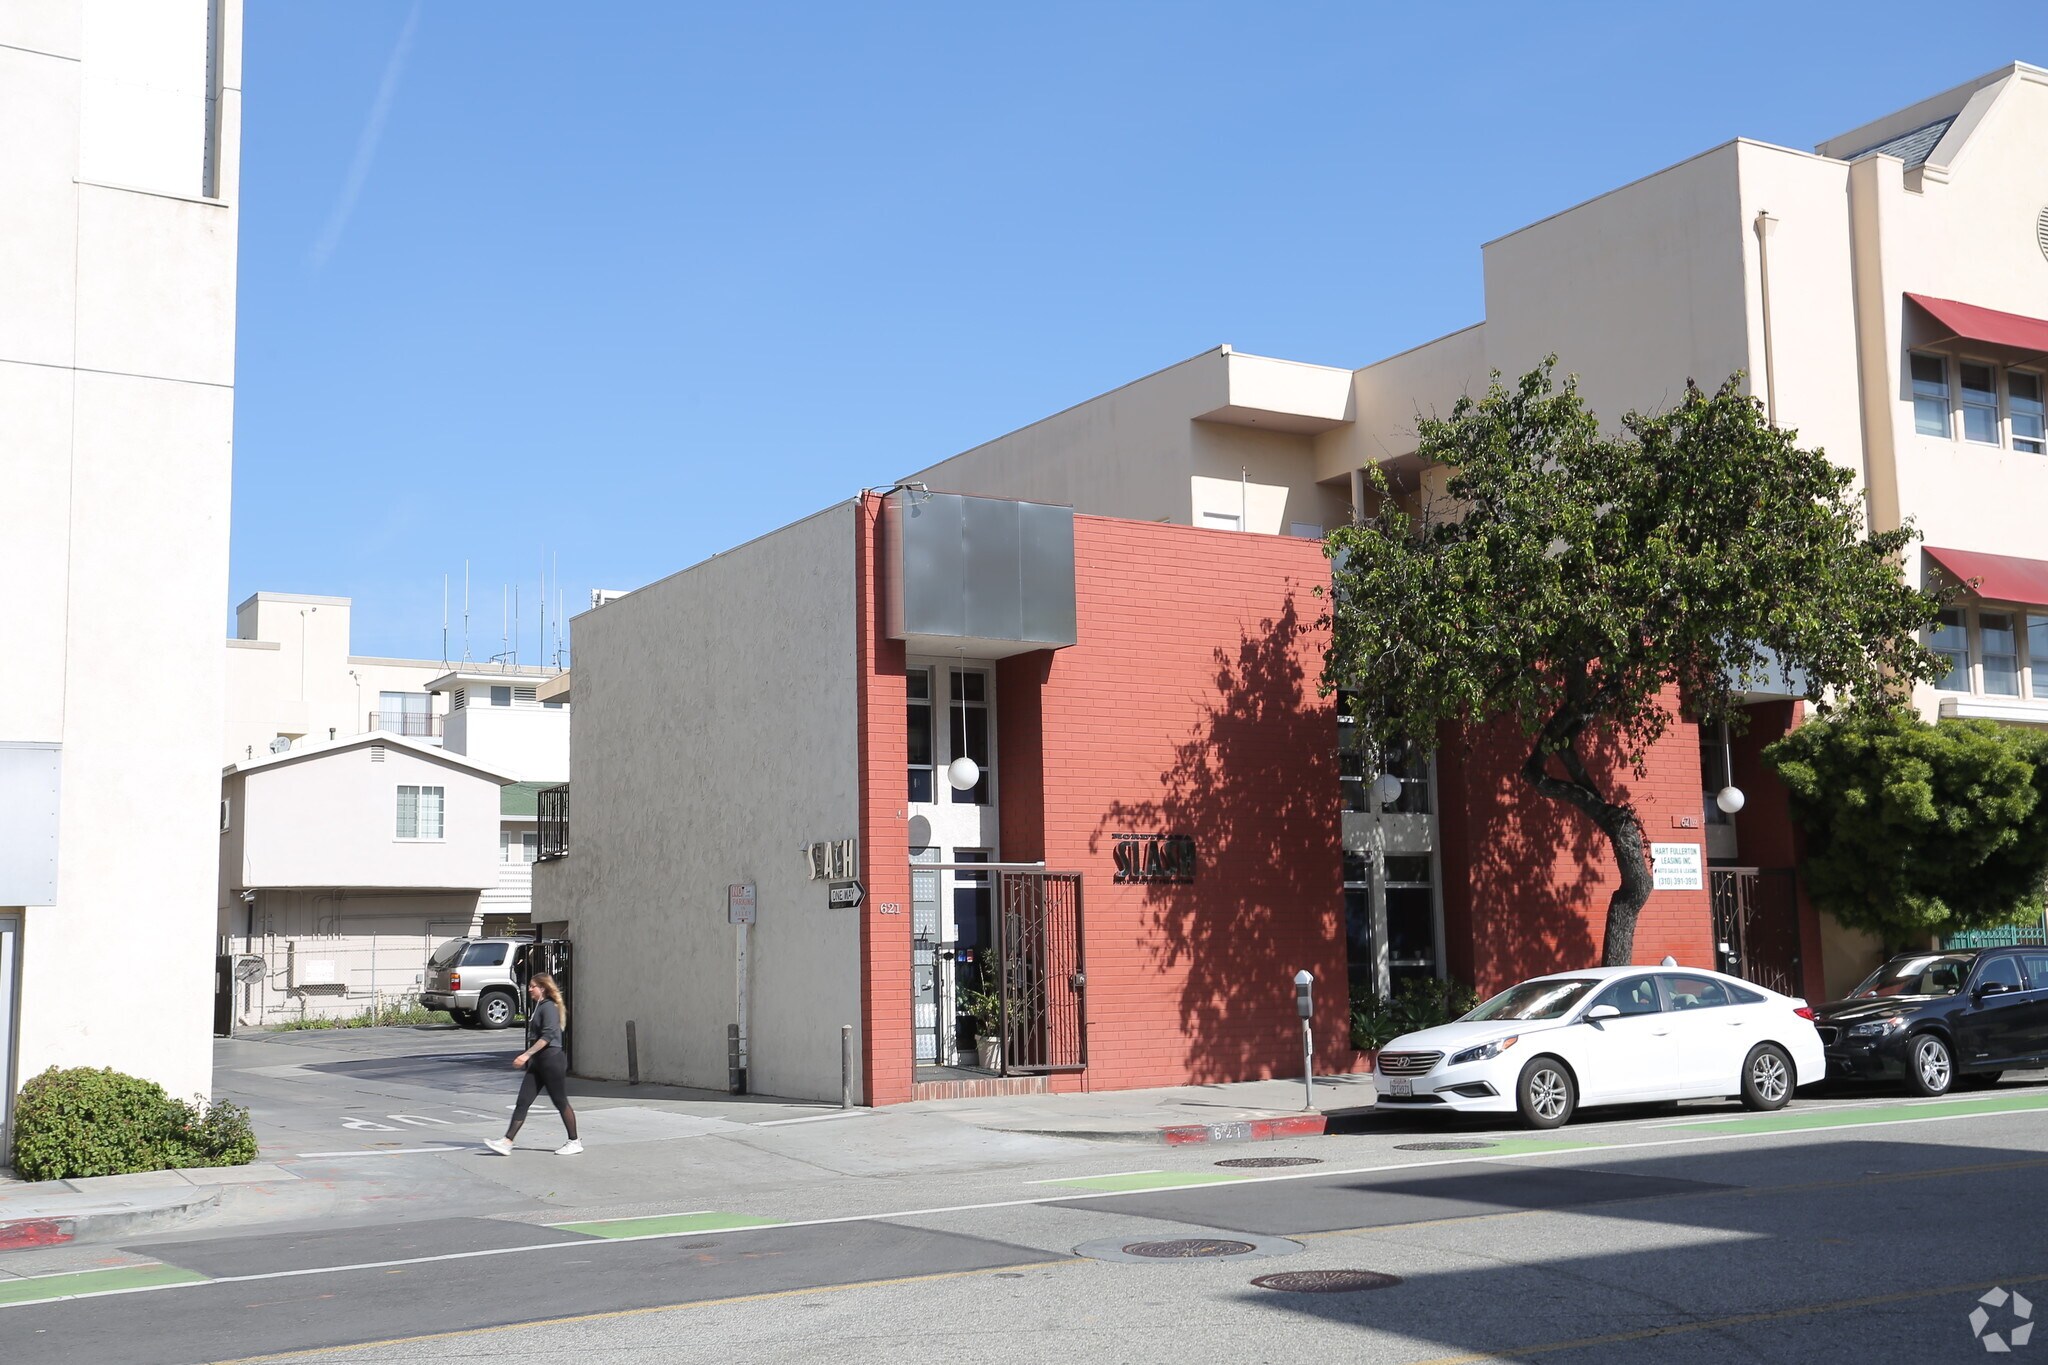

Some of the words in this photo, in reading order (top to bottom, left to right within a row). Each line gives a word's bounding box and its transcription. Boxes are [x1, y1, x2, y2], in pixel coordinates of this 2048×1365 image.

[1655, 847, 1668, 855] HART
[1670, 847, 1697, 855] FULLERTON
[1114, 840, 1197, 876] SLASH
[1661, 857, 1682, 865] LEASING
[1659, 877, 1672, 886] (310)
[732, 886, 742, 897] NO
[832, 890, 843, 902] ONE
[844, 889, 855, 901] WAY
[732, 898, 754, 906] PARKING
[880, 903, 901, 914] 621
[1214, 1127, 1241, 1140] 621
